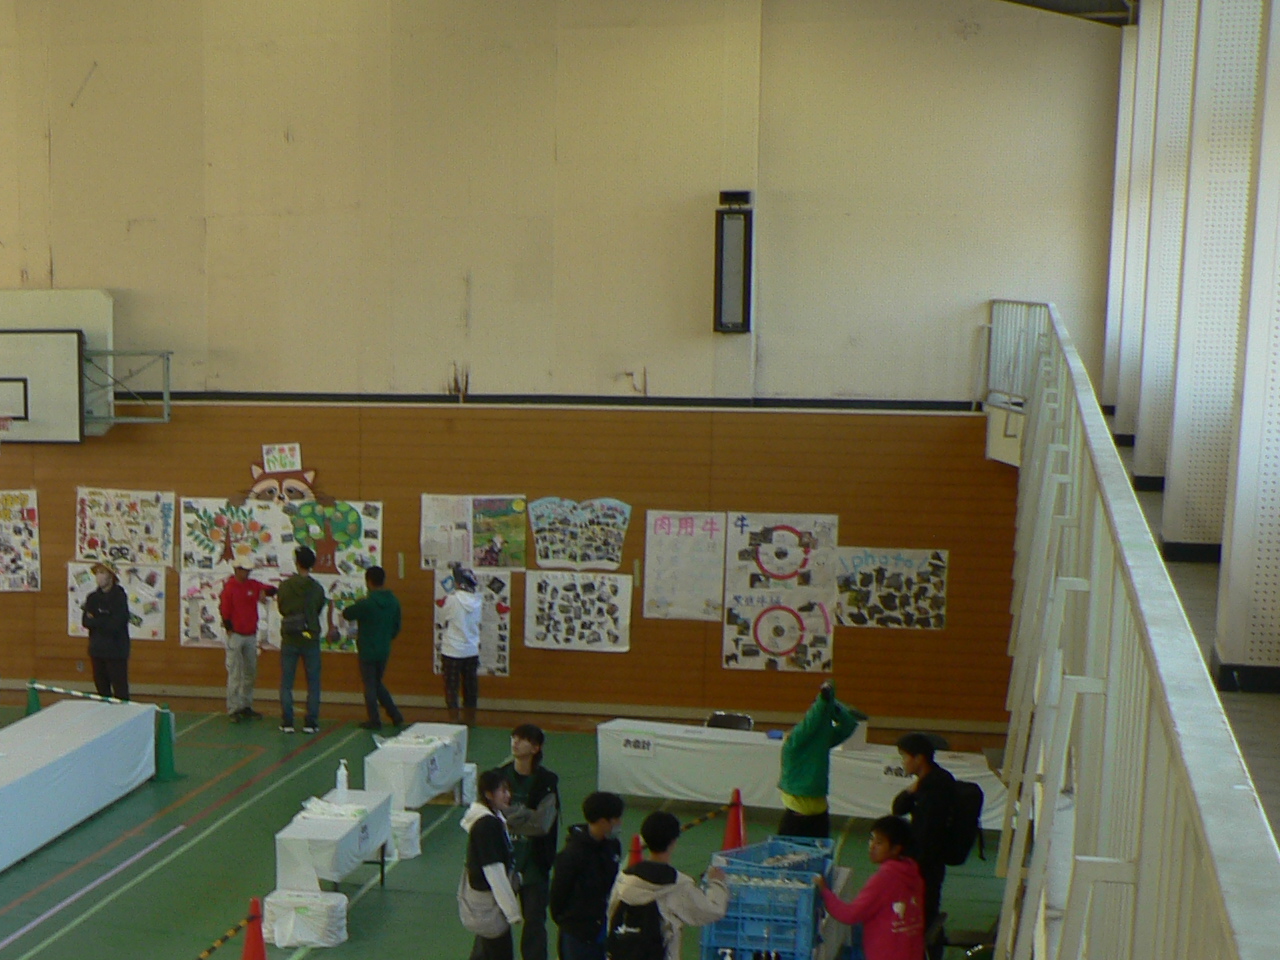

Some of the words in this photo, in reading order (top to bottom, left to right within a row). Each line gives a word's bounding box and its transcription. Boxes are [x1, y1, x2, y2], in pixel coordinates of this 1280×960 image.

[653, 514, 721, 540] 肉用牛
[622, 738, 652, 751] お会計
[883, 765, 913, 778] お会
